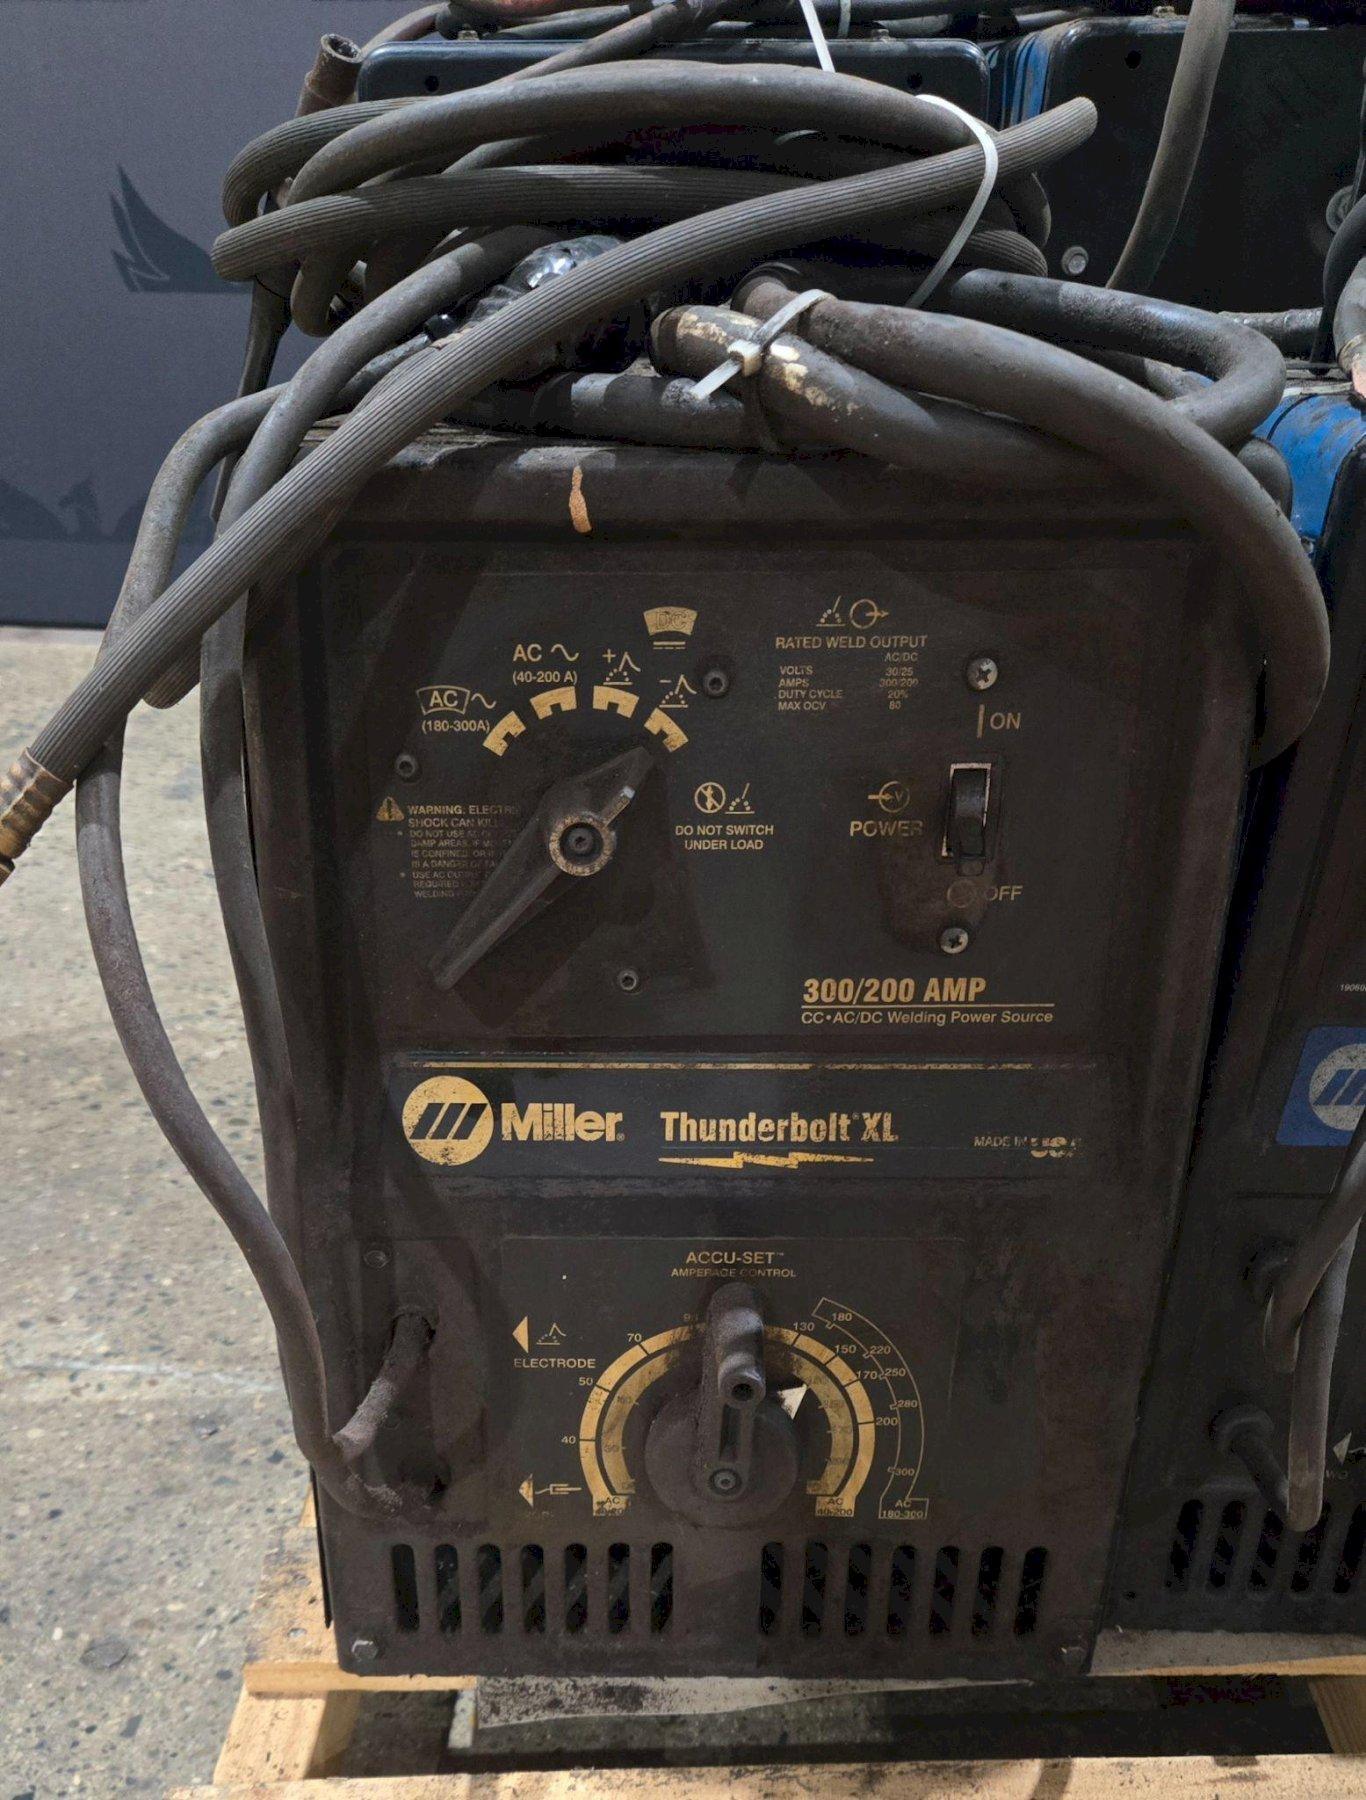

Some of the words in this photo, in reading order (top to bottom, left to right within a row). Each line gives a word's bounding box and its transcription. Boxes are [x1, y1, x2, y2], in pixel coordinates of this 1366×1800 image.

[775, 636, 822, 649] RATED
[826, 635, 866, 648] WELD
[869, 634, 928, 648] OUTPUT
[512, 643, 542, 663] AC
[779, 665, 813, 675] VOLTS
[512, 670, 561, 685] (40-200
[563, 670, 578, 685] A)
[778, 678, 810, 688] AMPS
[428, 690, 459, 708] AC
[778, 689, 807, 699] DUTY
[809, 689, 843, 699] CYCLE
[778, 701, 801, 711] MAX
[803, 701, 826, 711] OCV
[989, 712, 1022, 730] ON
[421, 719, 491, 735] (180-300A)
[408, 818, 448, 828] SHOCK
[451, 818, 475, 828] CAN
[410, 829, 423, 838] DO
[425, 829, 444, 838] NOT
[447, 829, 465, 838] USE
[675, 825, 693, 836] DO
[697, 825, 723, 836] NOT
[725, 825, 774, 836] SWITCH
[850, 820, 923, 838] POWER
[411, 839, 436, 848] DAMP
[684, 839, 728, 850] UNDER
[730, 839, 764, 850] LOAD
[422, 860, 430, 869] A
[412, 870, 430, 880] USE
[433, 870, 445, 880] AC
[414, 890, 454, 899] WELDING
[984, 885, 1024, 902] OFF
[802, 977, 916, 1005] 300/200
[923, 977, 987, 1002] AMP
[887, 1010, 946, 1027] Welding
[950, 1010, 997, 1024] Power
[1000, 1010, 1054, 1024] Source
[861, 1111, 899, 1143] XL
[974, 1135, 1011, 1148] MADE
[671, 1268, 736, 1278] AMPERAGE
[740, 1268, 797, 1278] CONTROL
[832, 1312, 852, 1322] 180
[793, 1321, 815, 1332] 130
[626, 1333, 642, 1343] 70
[835, 1344, 856, 1354] 150
[869, 1345, 890, 1355] 220
[514, 1358, 596, 1369] ELECTRODE
[856, 1370, 876, 1380] 170
[884, 1368, 905, 1378] 250
[578, 1377, 593, 1386] 50
[897, 1399, 918, 1409] 280
[875, 1417, 898, 1427] 200
[561, 1435, 576, 1445] 40
[895, 1467, 915, 1477] 300
[827, 1497, 843, 1506] AC
[895, 1499, 912, 1509] AC
